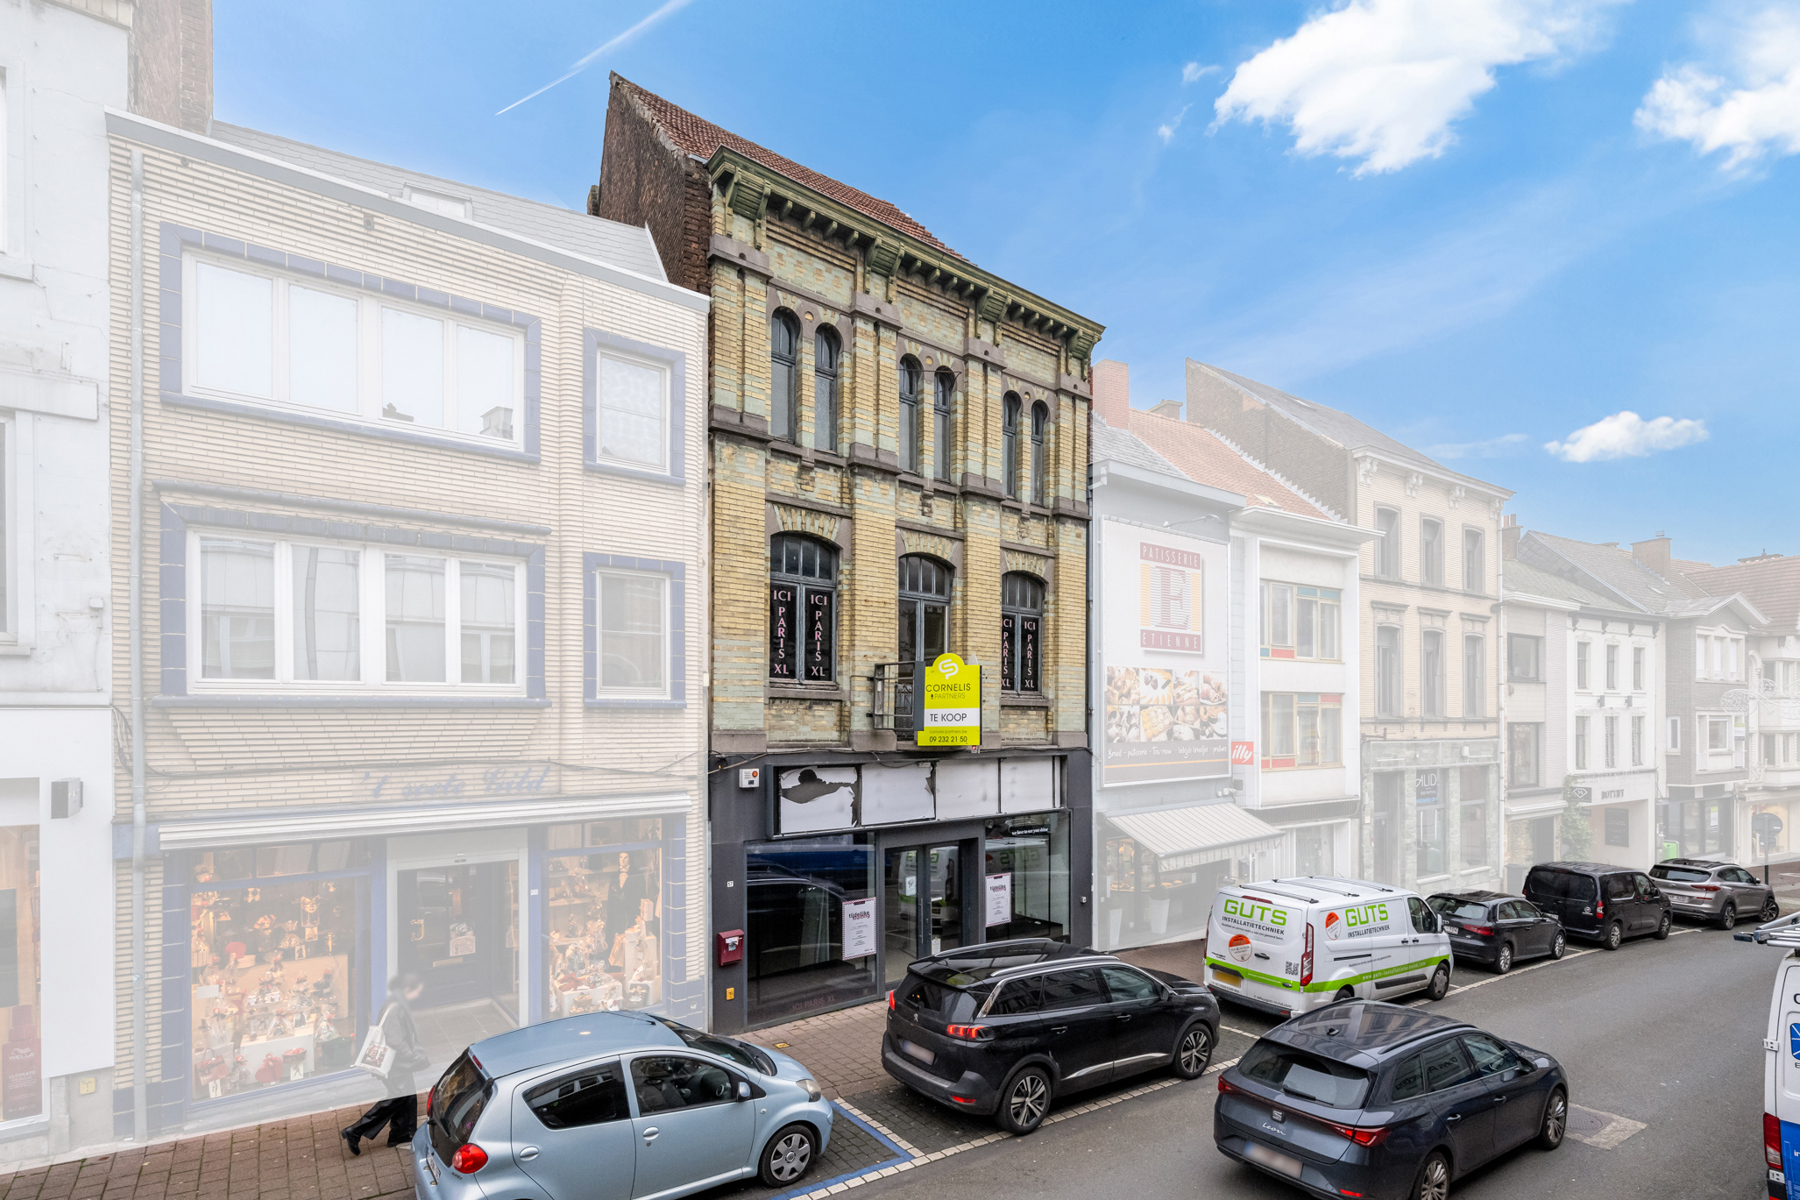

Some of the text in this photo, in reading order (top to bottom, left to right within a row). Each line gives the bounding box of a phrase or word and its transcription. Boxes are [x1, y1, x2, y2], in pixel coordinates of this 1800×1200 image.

[1143, 545, 1198, 567] PATISSERIE
[773, 590, 791, 675] ICI PARIS XL
[1024, 621, 1036, 630] ICI
[810, 594, 827, 677] ICI PARIS XL
[1142, 632, 1197, 649] ETIENNE
[925, 683, 971, 692] CORNELIS
[1001, 678, 1011, 687] XL
[1024, 679, 1035, 688] XL
[930, 712, 967, 722] TE KOOP
[1232, 744, 1253, 763] illy
[1224, 899, 1288, 926] GUTS
[1345, 903, 1388, 927] GUTS
[1222, 916, 1285, 935] INSTALLATIETECHNIEK
[1347, 924, 1391, 938] INSTALLATIETECHNIEK
[9, 1052, 35, 1060] WELLA
